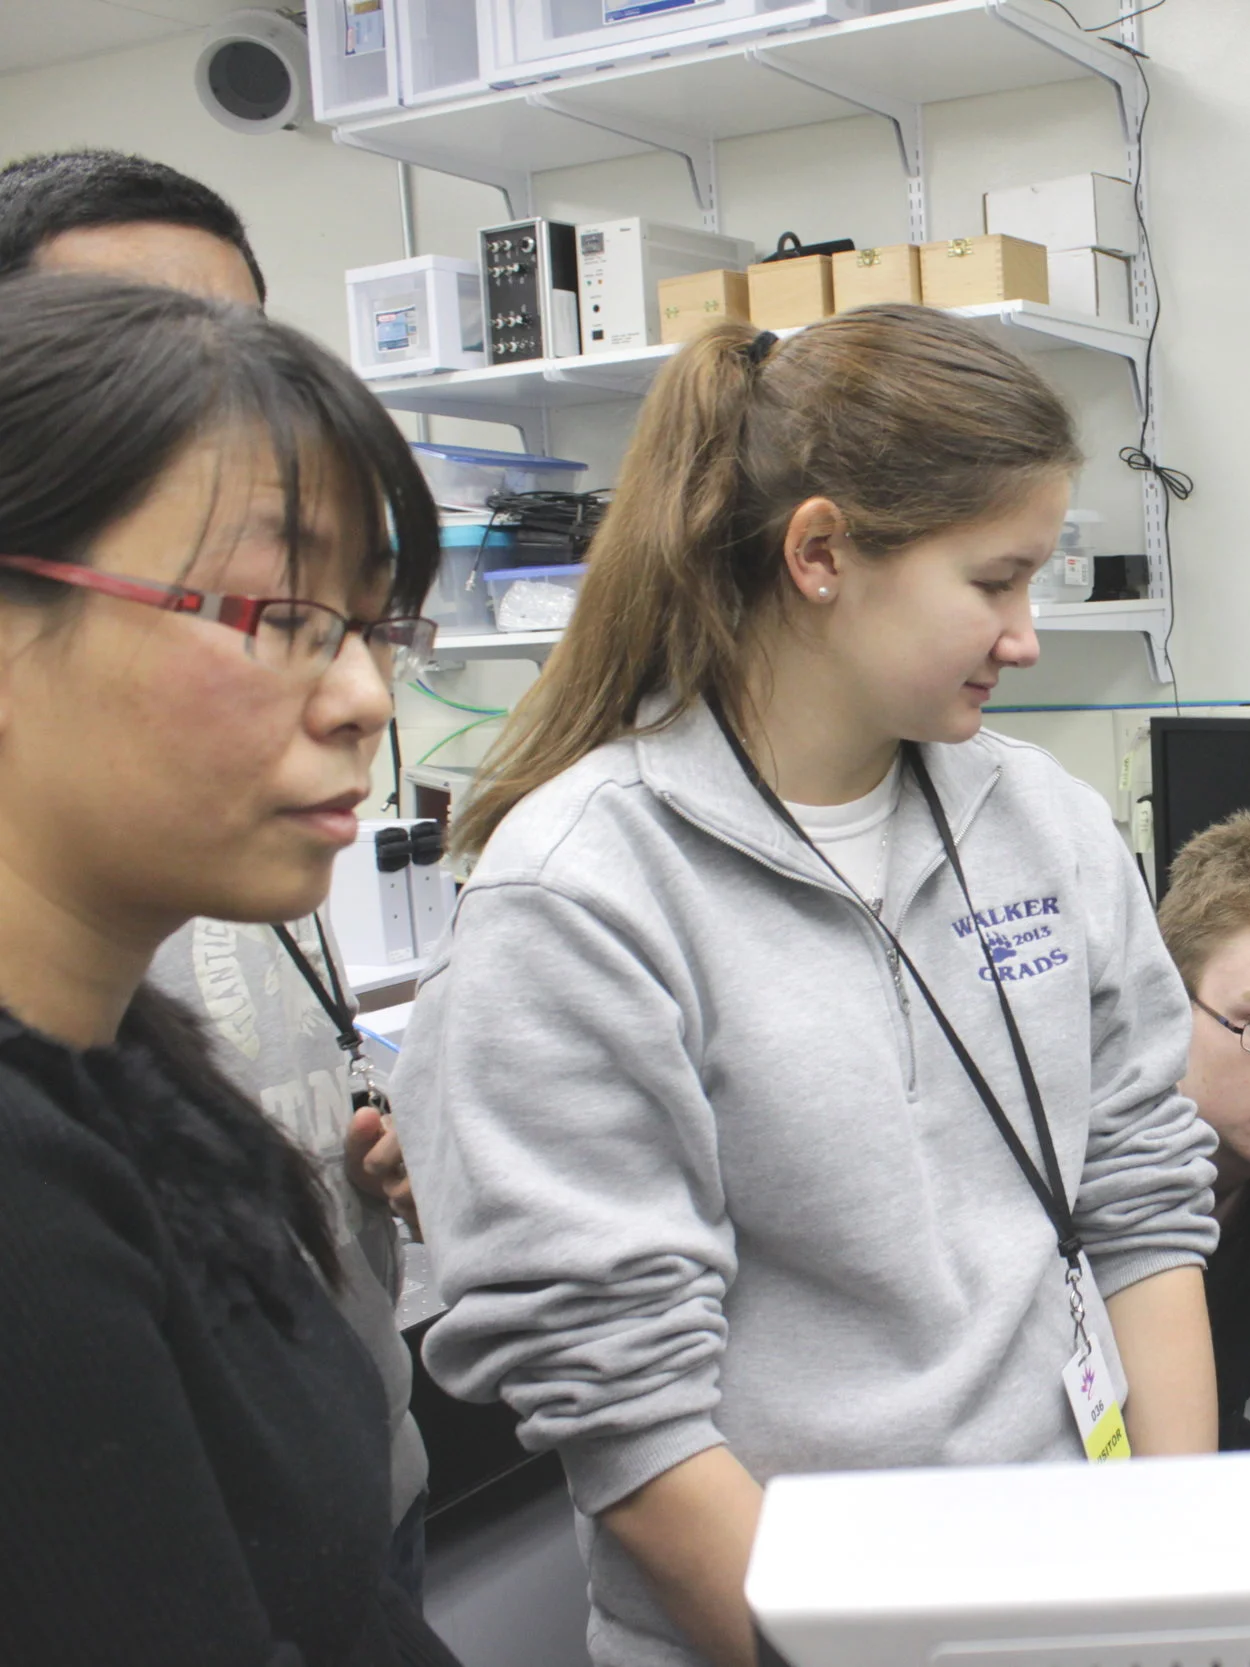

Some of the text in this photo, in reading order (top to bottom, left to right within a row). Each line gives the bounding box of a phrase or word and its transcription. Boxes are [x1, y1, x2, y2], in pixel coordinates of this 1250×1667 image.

[951, 896, 1061, 939] WALKER
[1012, 925, 1053, 946] 2013
[978, 948, 1069, 981] GRADS
[1090, 1399, 1105, 1422] 036
[1096, 1428, 1123, 1465] ISITOR
